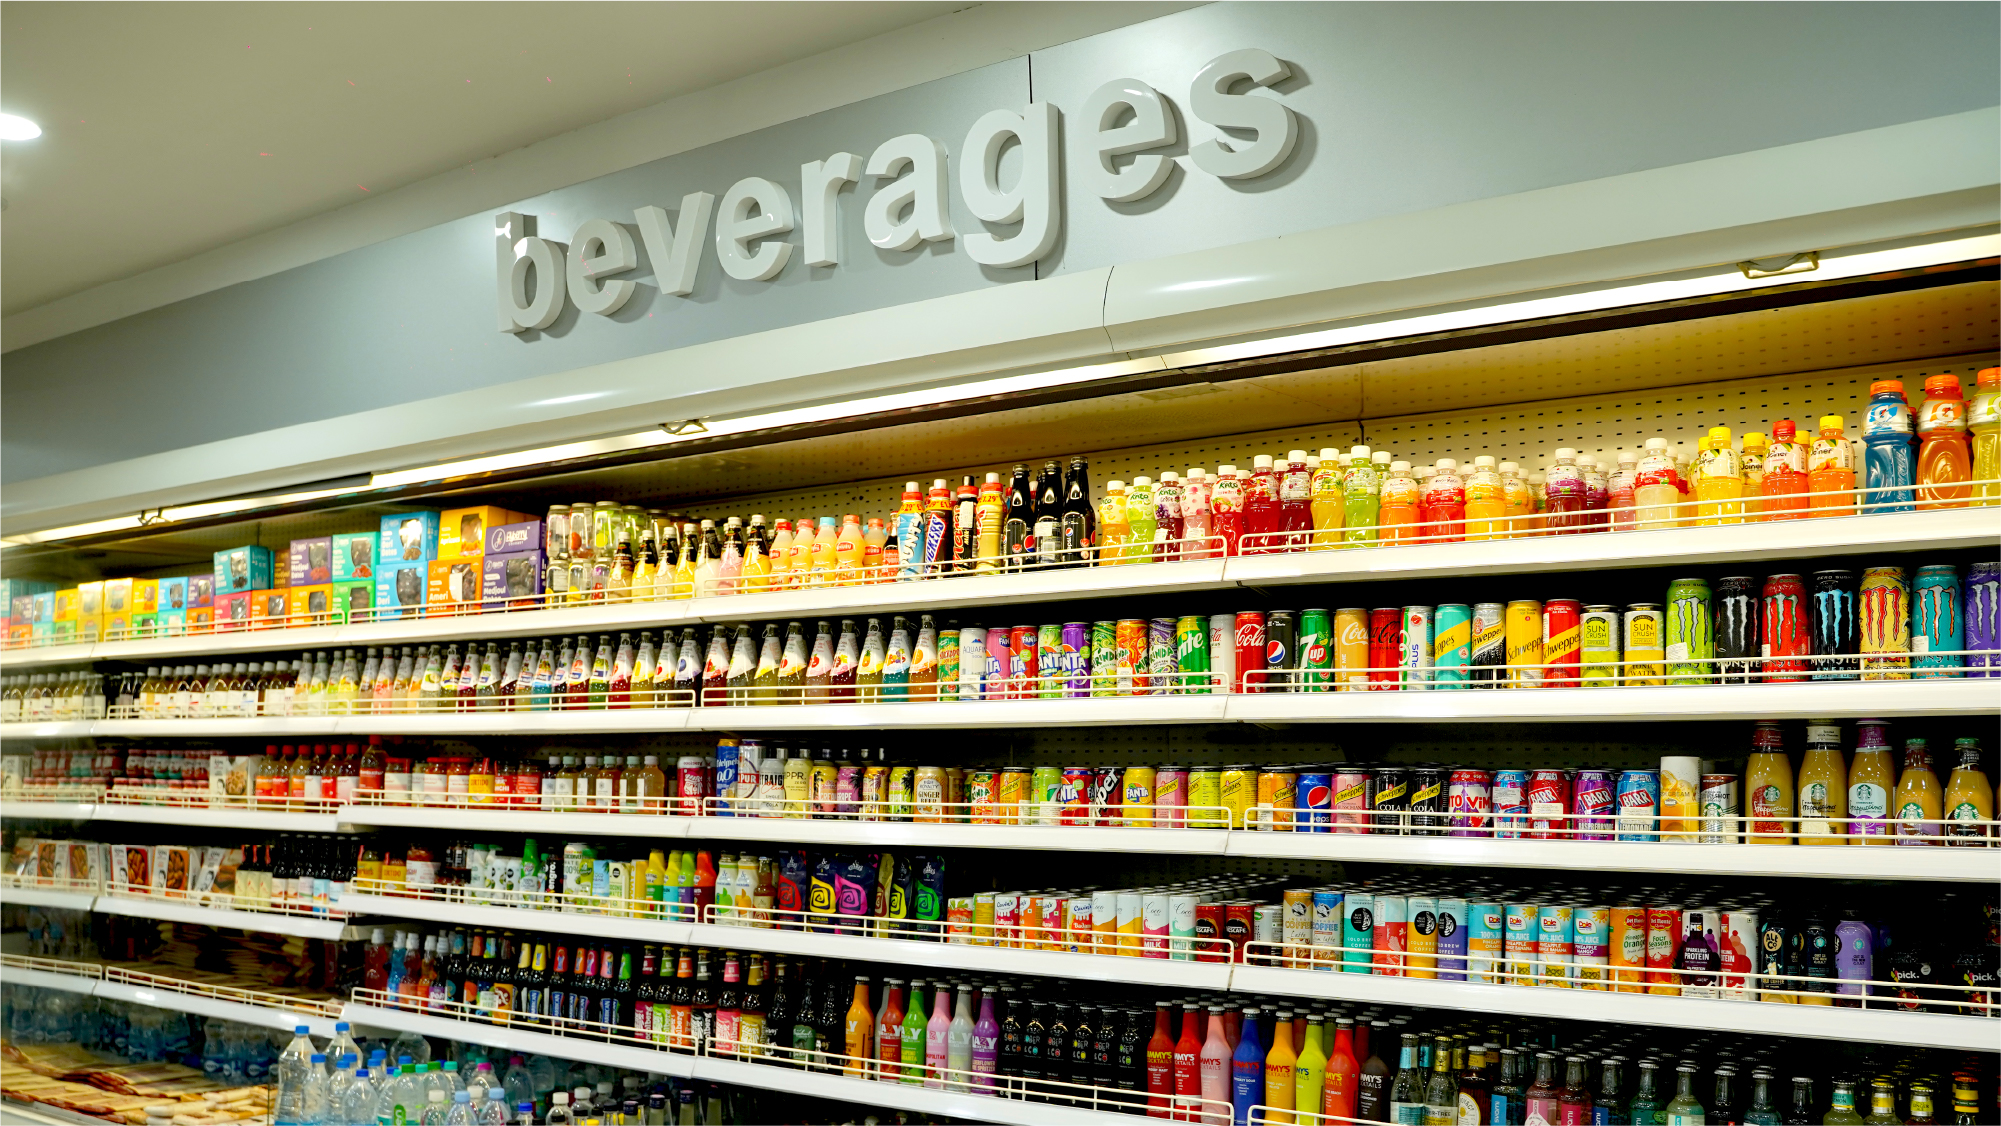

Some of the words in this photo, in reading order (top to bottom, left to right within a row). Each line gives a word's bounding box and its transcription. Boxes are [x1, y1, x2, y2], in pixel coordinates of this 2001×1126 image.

[495, 47, 1302, 334] beverages
[1936, 402, 1954, 422] G
[1766, 450, 1788, 459] Joiner
[1810, 446, 1832, 456] Joiner
[428, 591, 448, 600] Ameri
[483, 586, 506, 596] Medjoul
[1236, 624, 1266, 646] Cola
[1310, 648, 1324, 660] up
[1126, 787, 1148, 797] FANTA
[1530, 788, 1556, 804] BARR
[1584, 792, 1610, 806] BARR
[1622, 794, 1648, 807] BARR
[548, 861, 557, 890] engro.
[1145, 902, 1162, 915] Coco
[1174, 902, 1192, 915] Coco
[1313, 923, 1338, 931] COFFEE
[1896, 970, 1919, 980] pick.
[1972, 972, 1995, 982] pick.
